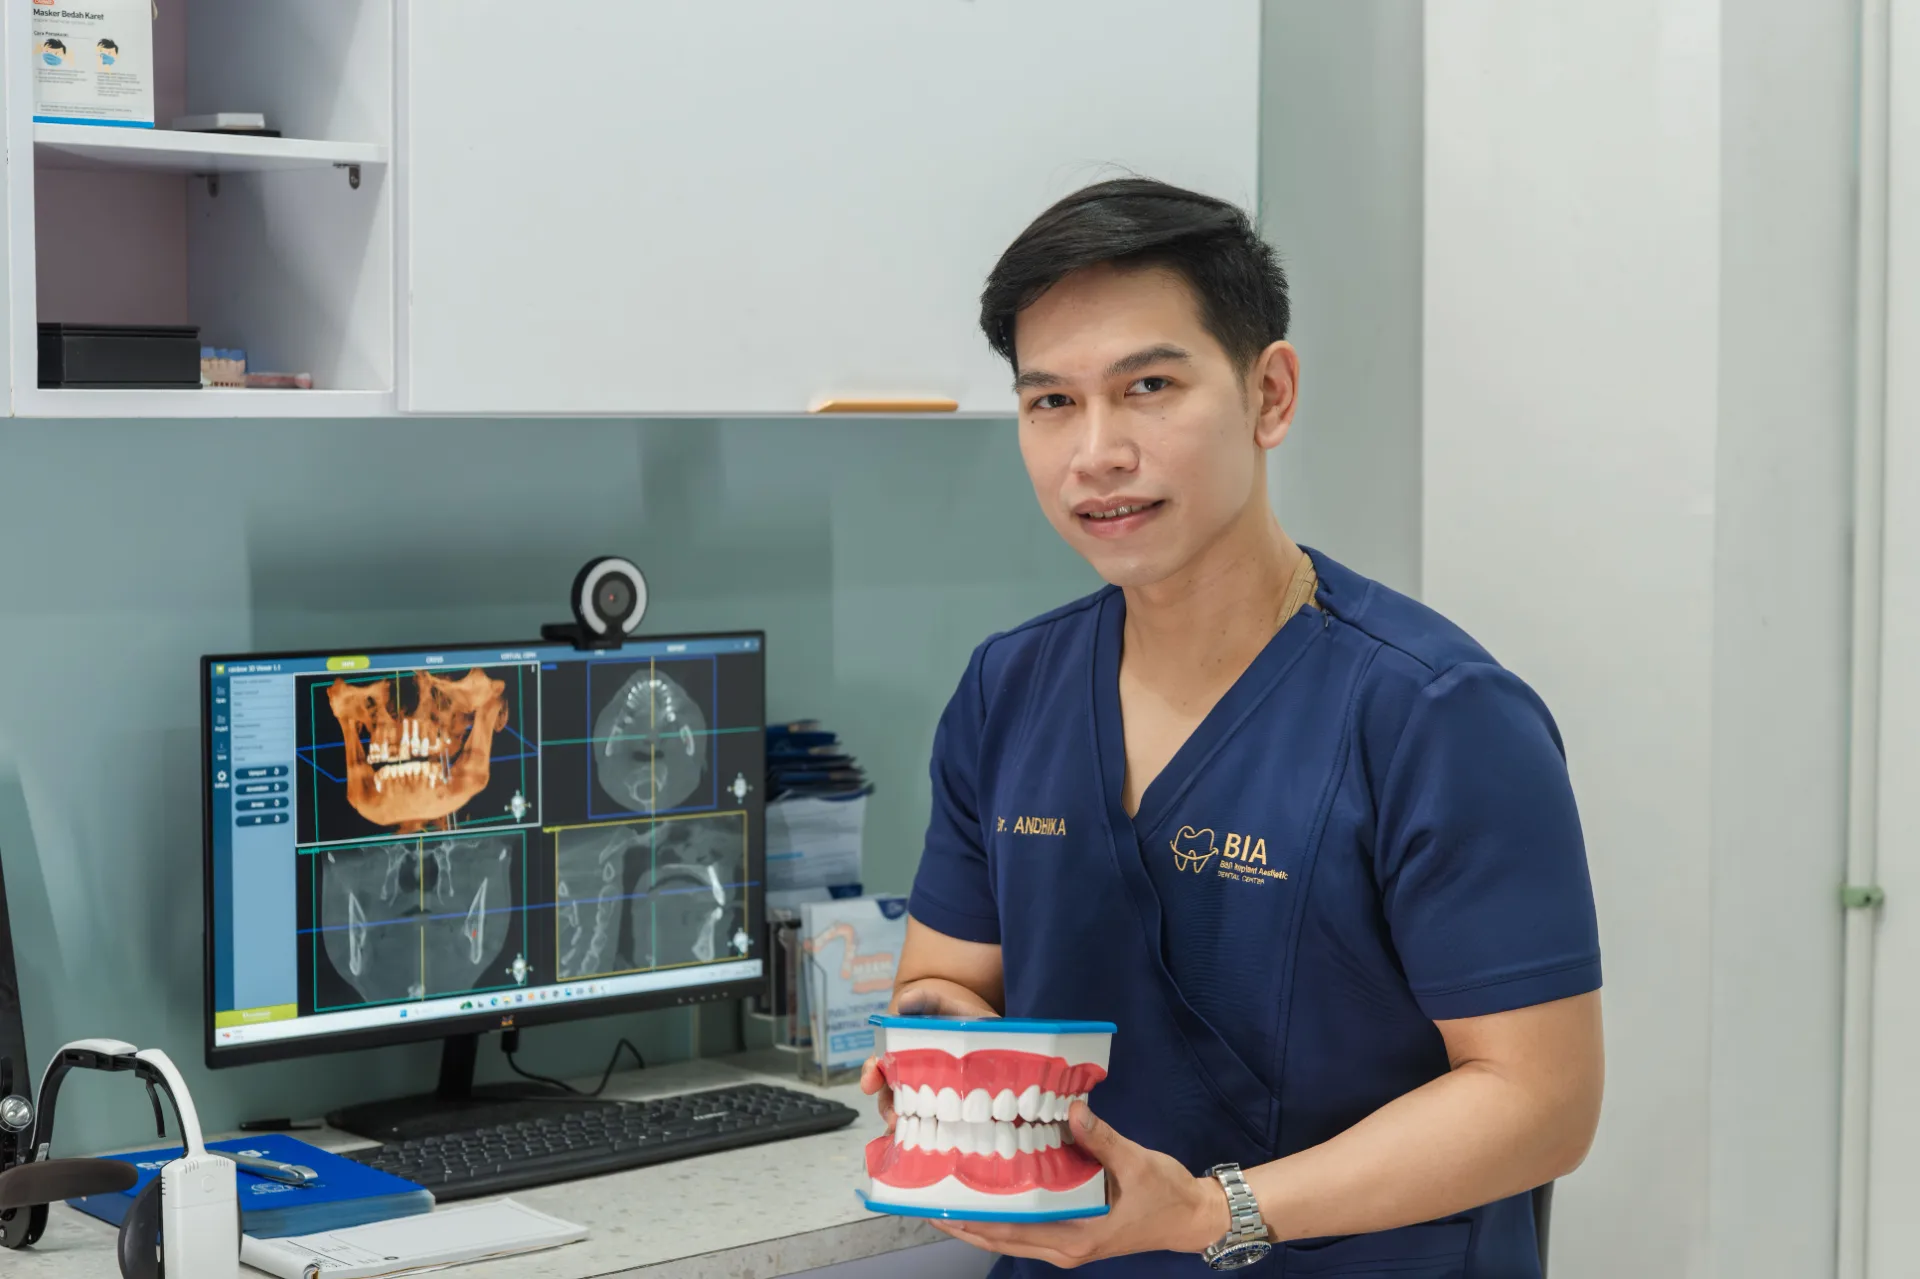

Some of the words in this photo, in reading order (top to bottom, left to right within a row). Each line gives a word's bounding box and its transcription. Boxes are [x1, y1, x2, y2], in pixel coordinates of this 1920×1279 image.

[33, 9, 60, 17] Masker
[61, 10, 84, 18] Bedah
[85, 12, 104, 20] Karet
[1013, 816, 1066, 836] ANDHIKA
[1223, 832, 1267, 865] BIA
[1234, 862, 1258, 875] Implant
[1217, 870, 1240, 881] DENTAL
[1241, 875, 1265, 885] CENTER
